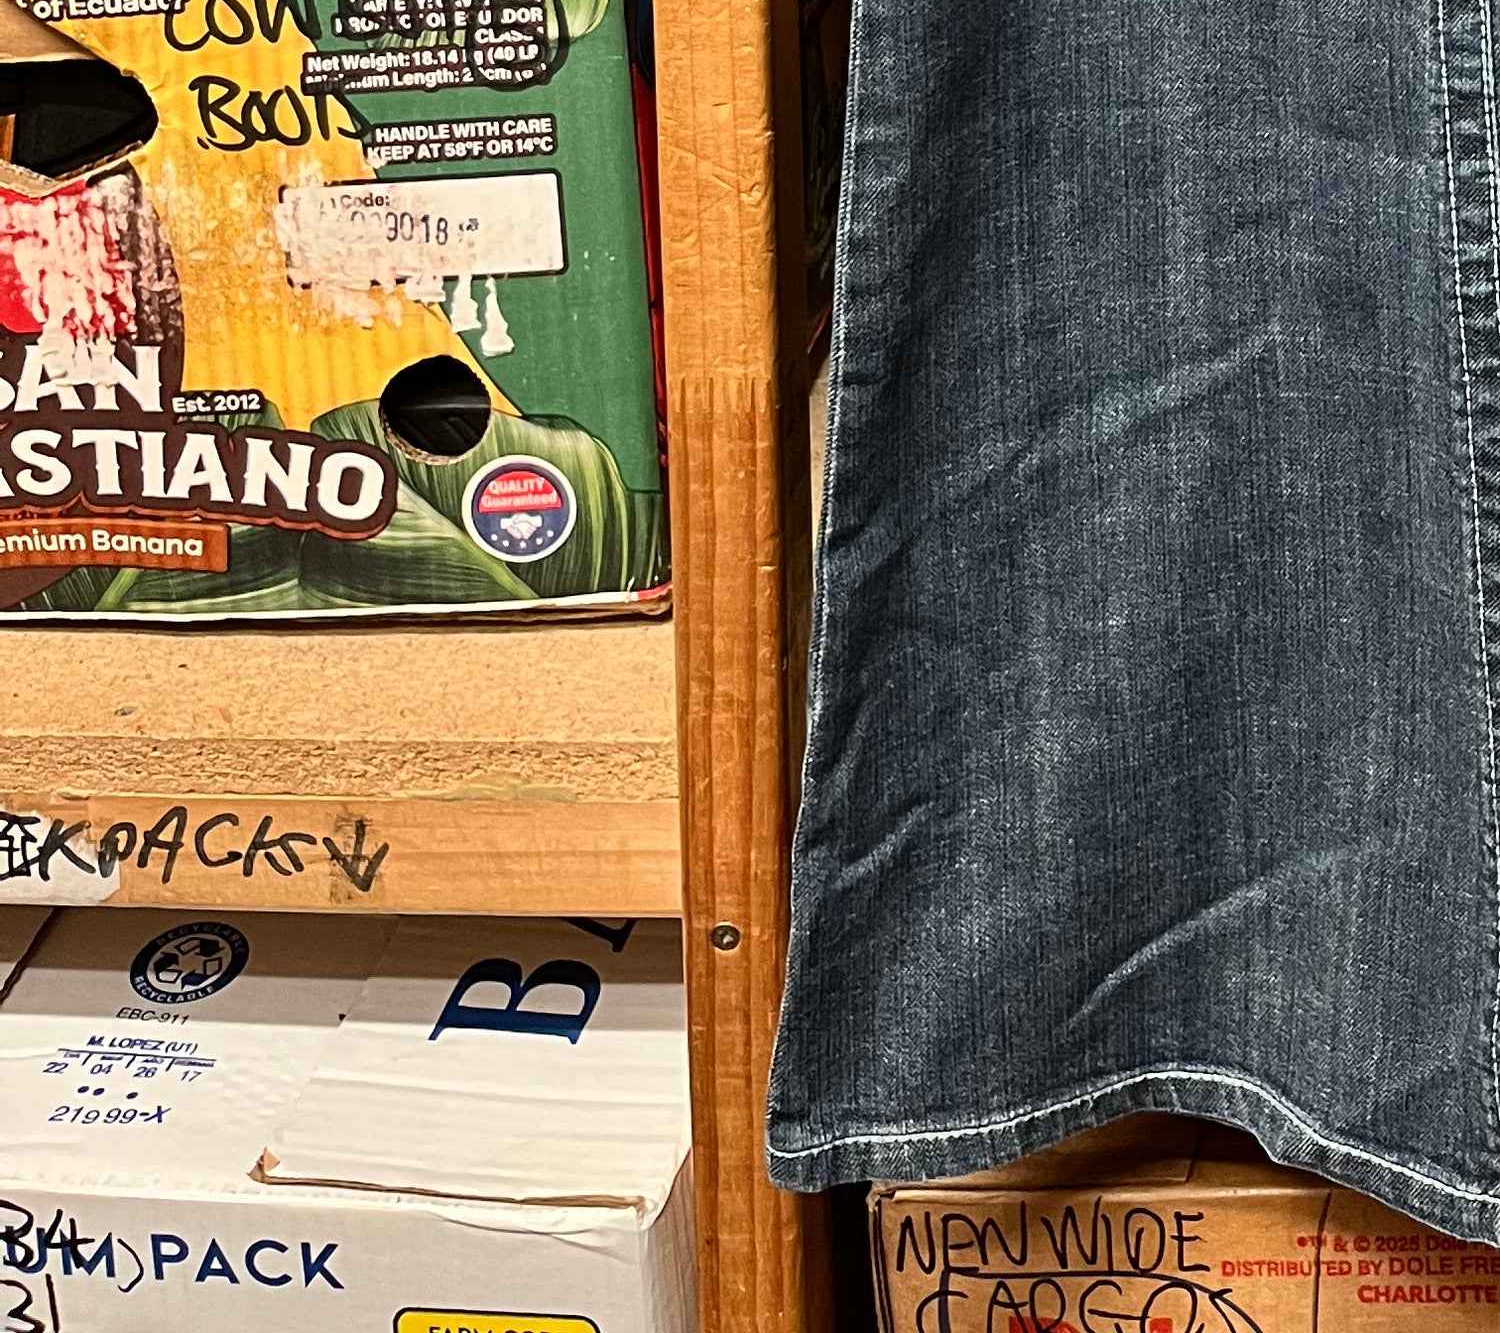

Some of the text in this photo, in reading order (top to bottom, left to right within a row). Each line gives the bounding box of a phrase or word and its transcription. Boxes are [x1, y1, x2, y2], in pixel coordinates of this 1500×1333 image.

[308, 49, 458, 72] Net Weight: 18.14
[393, 68, 460, 87] Length:
[376, 118, 552, 143] HANDLE WITH CARE
[367, 139, 514, 163] KEEP AT OR
[172, 393, 261, 414] Est. 2012
[0, 428, 385, 521] STIANO
[489, 478, 544, 494] QUALITY
[481, 490, 557, 507] Guaranteed
[92, 530, 203, 557] Banana
[133, 975, 217, 1003] RECYCLABLE
[116, 1007, 189, 1025] EBC-911
[108, 1037, 165, 1051] LOPEZ
[1041, 1196, 1211, 1274] WIDE
[152, 1233, 345, 1290] PACK
[1221, 1256, 1453, 1278] DISTRIBUTED DOLE
[1357, 1283, 1499, 1304] CHARLOTTE
